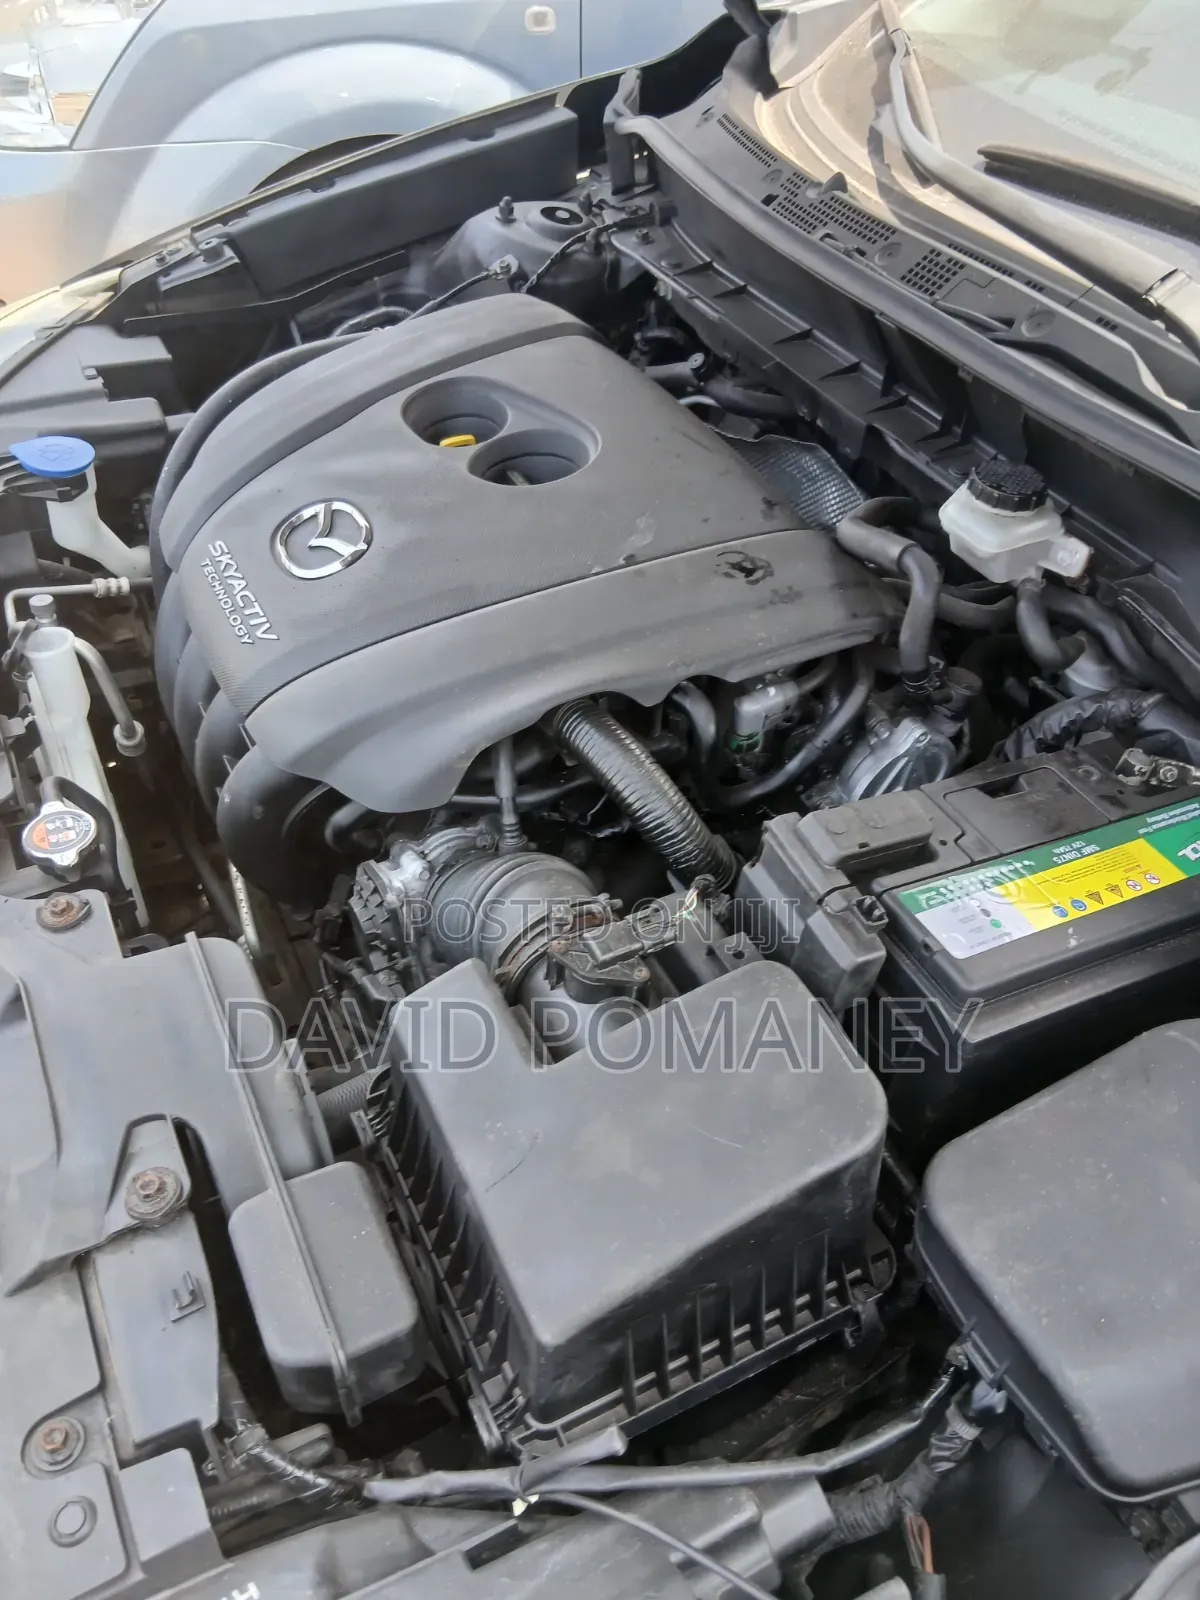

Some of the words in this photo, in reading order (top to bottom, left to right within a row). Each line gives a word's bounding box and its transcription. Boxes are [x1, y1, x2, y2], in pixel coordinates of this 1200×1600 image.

[208, 540, 280, 641] SKYACTIV
[200, 557, 254, 645] TECHNOLOGY
[1071, 840, 1086, 849] 12V
[1081, 844, 1100, 856] SMF
[1052, 850, 1081, 864] DIN75
